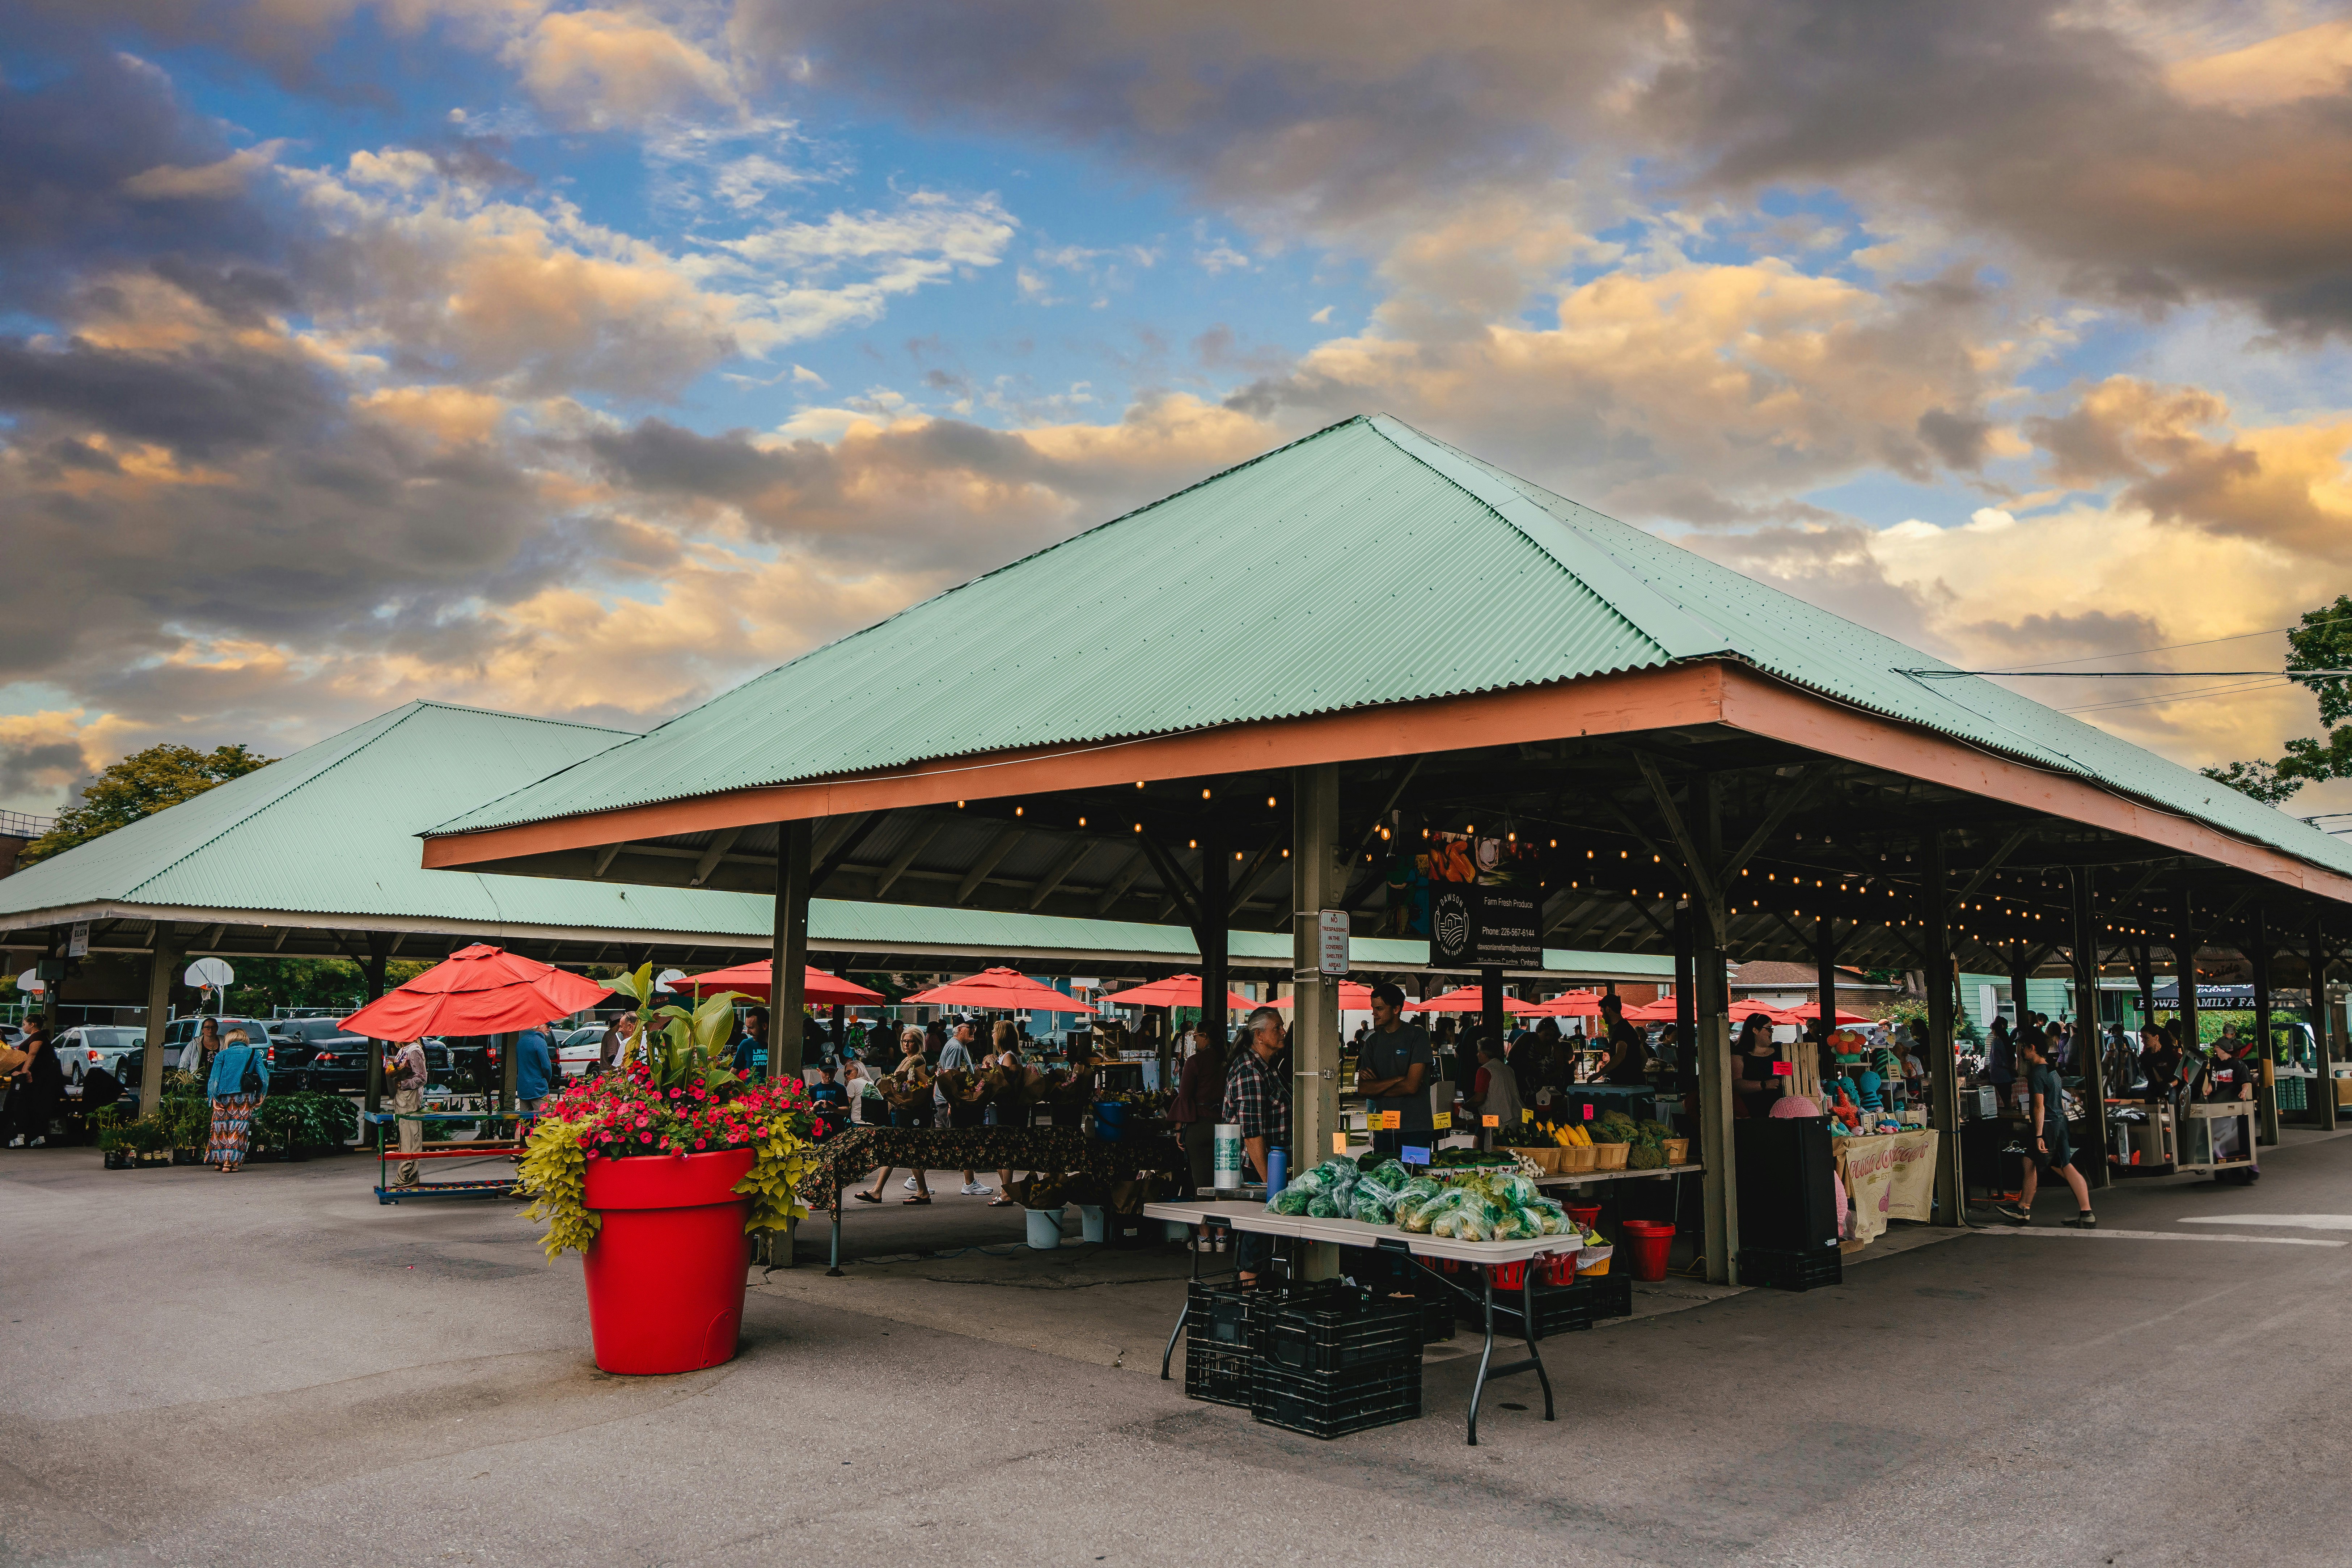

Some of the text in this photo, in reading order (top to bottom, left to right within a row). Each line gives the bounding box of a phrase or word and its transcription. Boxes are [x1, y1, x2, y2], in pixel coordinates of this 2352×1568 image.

[1440, 893, 1463, 907] DAWSON
[1484, 897, 1533, 908] Farm Fresh Produce
[1482, 927, 1535, 937] Phone: 226-567-6144
[1441, 944, 1463, 956] LANE FARMS
[1477, 943, 1540, 952] dawsonlanefarms@outlook.com
